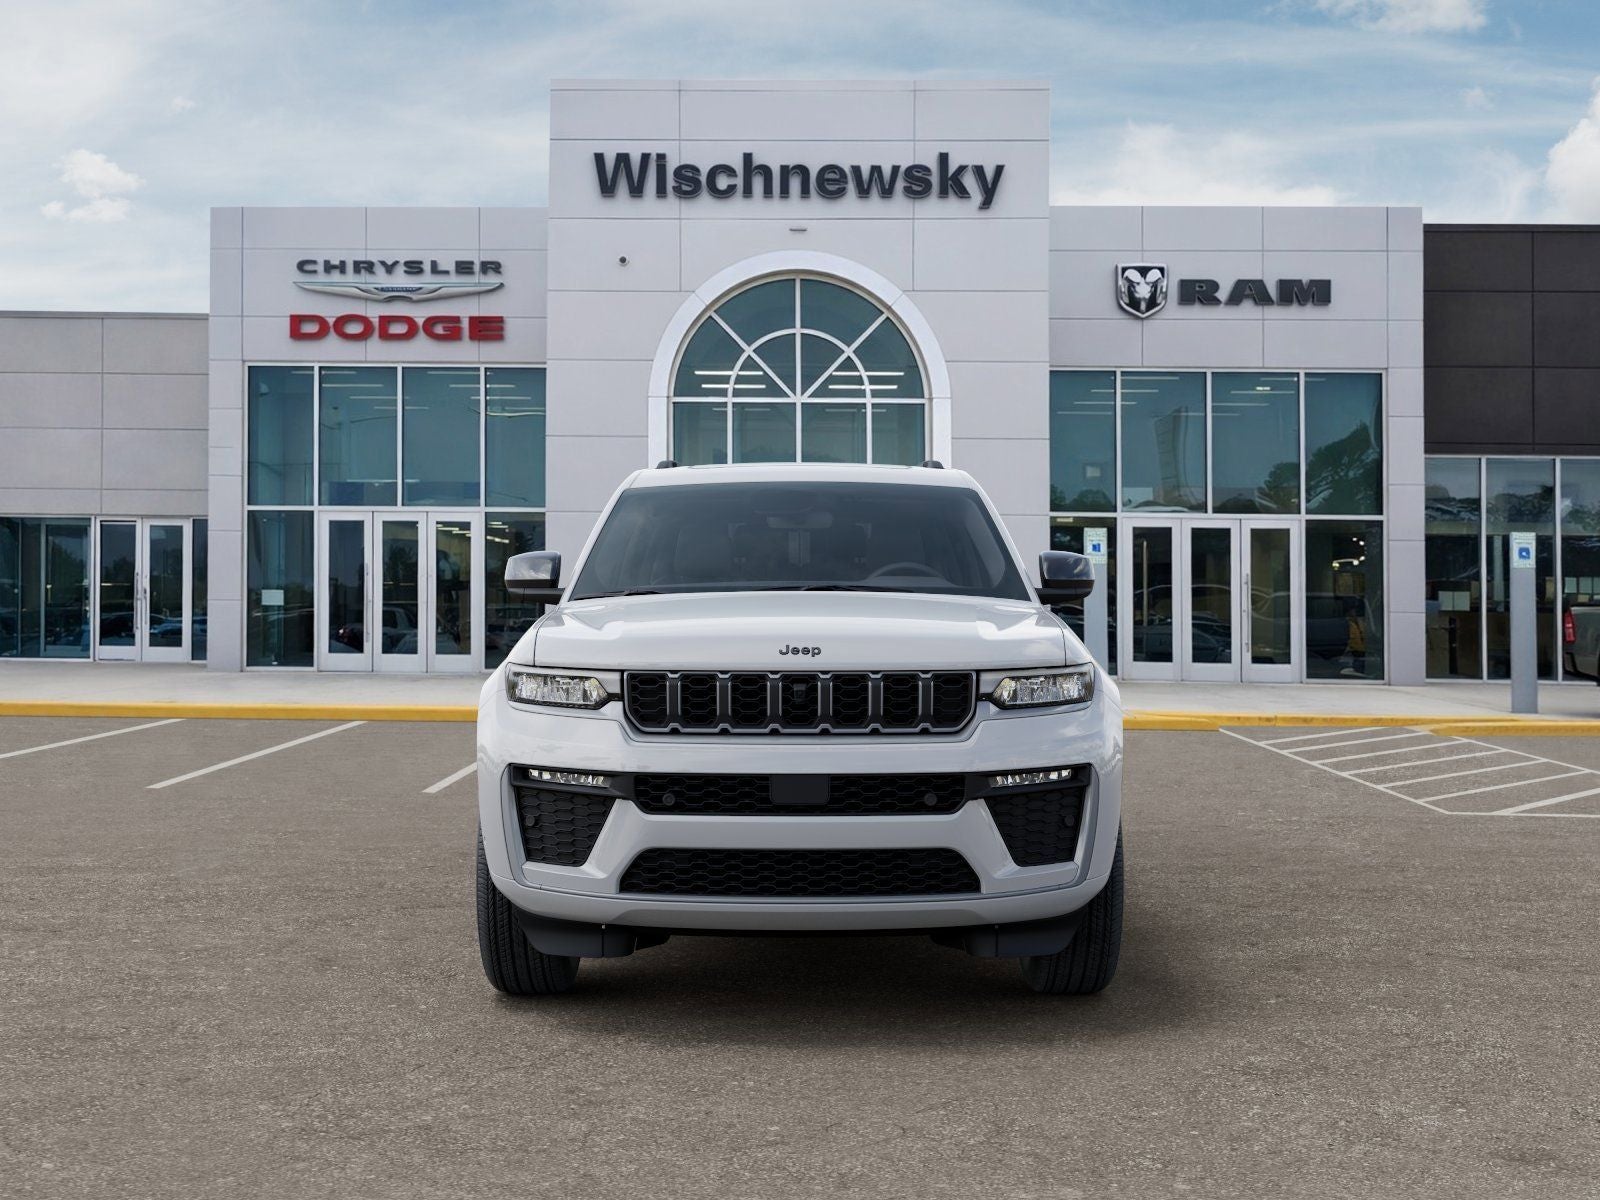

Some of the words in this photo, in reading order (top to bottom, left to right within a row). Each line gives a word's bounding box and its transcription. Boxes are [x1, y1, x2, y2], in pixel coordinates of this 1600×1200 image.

[594, 152, 1005, 210] Wischnewsky
[296, 259, 503, 275] CHRYSLER
[1177, 279, 1332, 306] RAM
[289, 314, 505, 341] DODGE
[779, 644, 822, 657] Jeep
